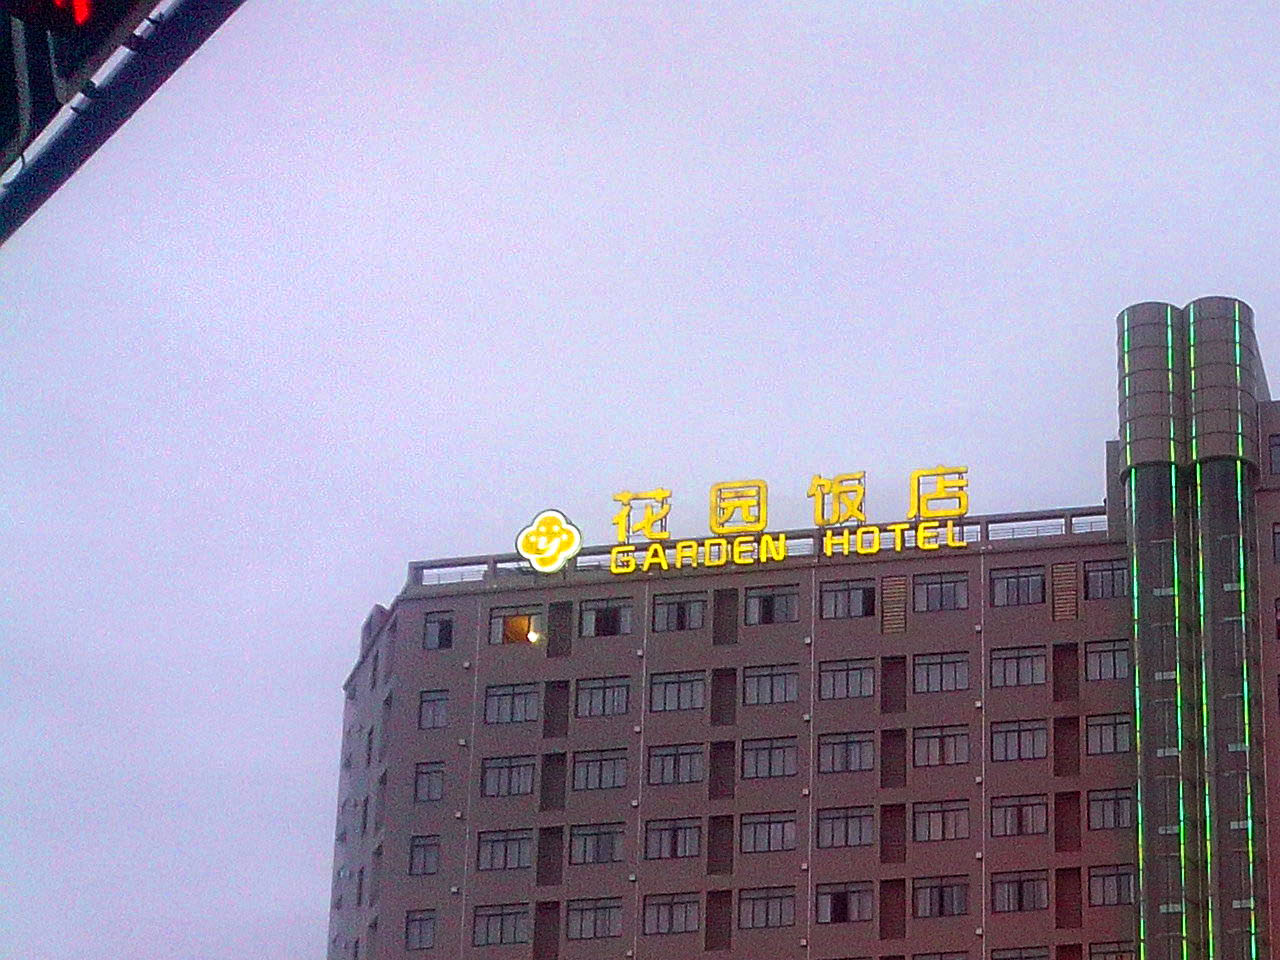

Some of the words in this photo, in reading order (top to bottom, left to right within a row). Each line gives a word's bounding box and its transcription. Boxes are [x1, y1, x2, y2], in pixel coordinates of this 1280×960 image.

[611, 465, 969, 542] 花园饭店
[610, 533, 787, 575] GARDEN
[824, 519, 968, 558] HOTEL
